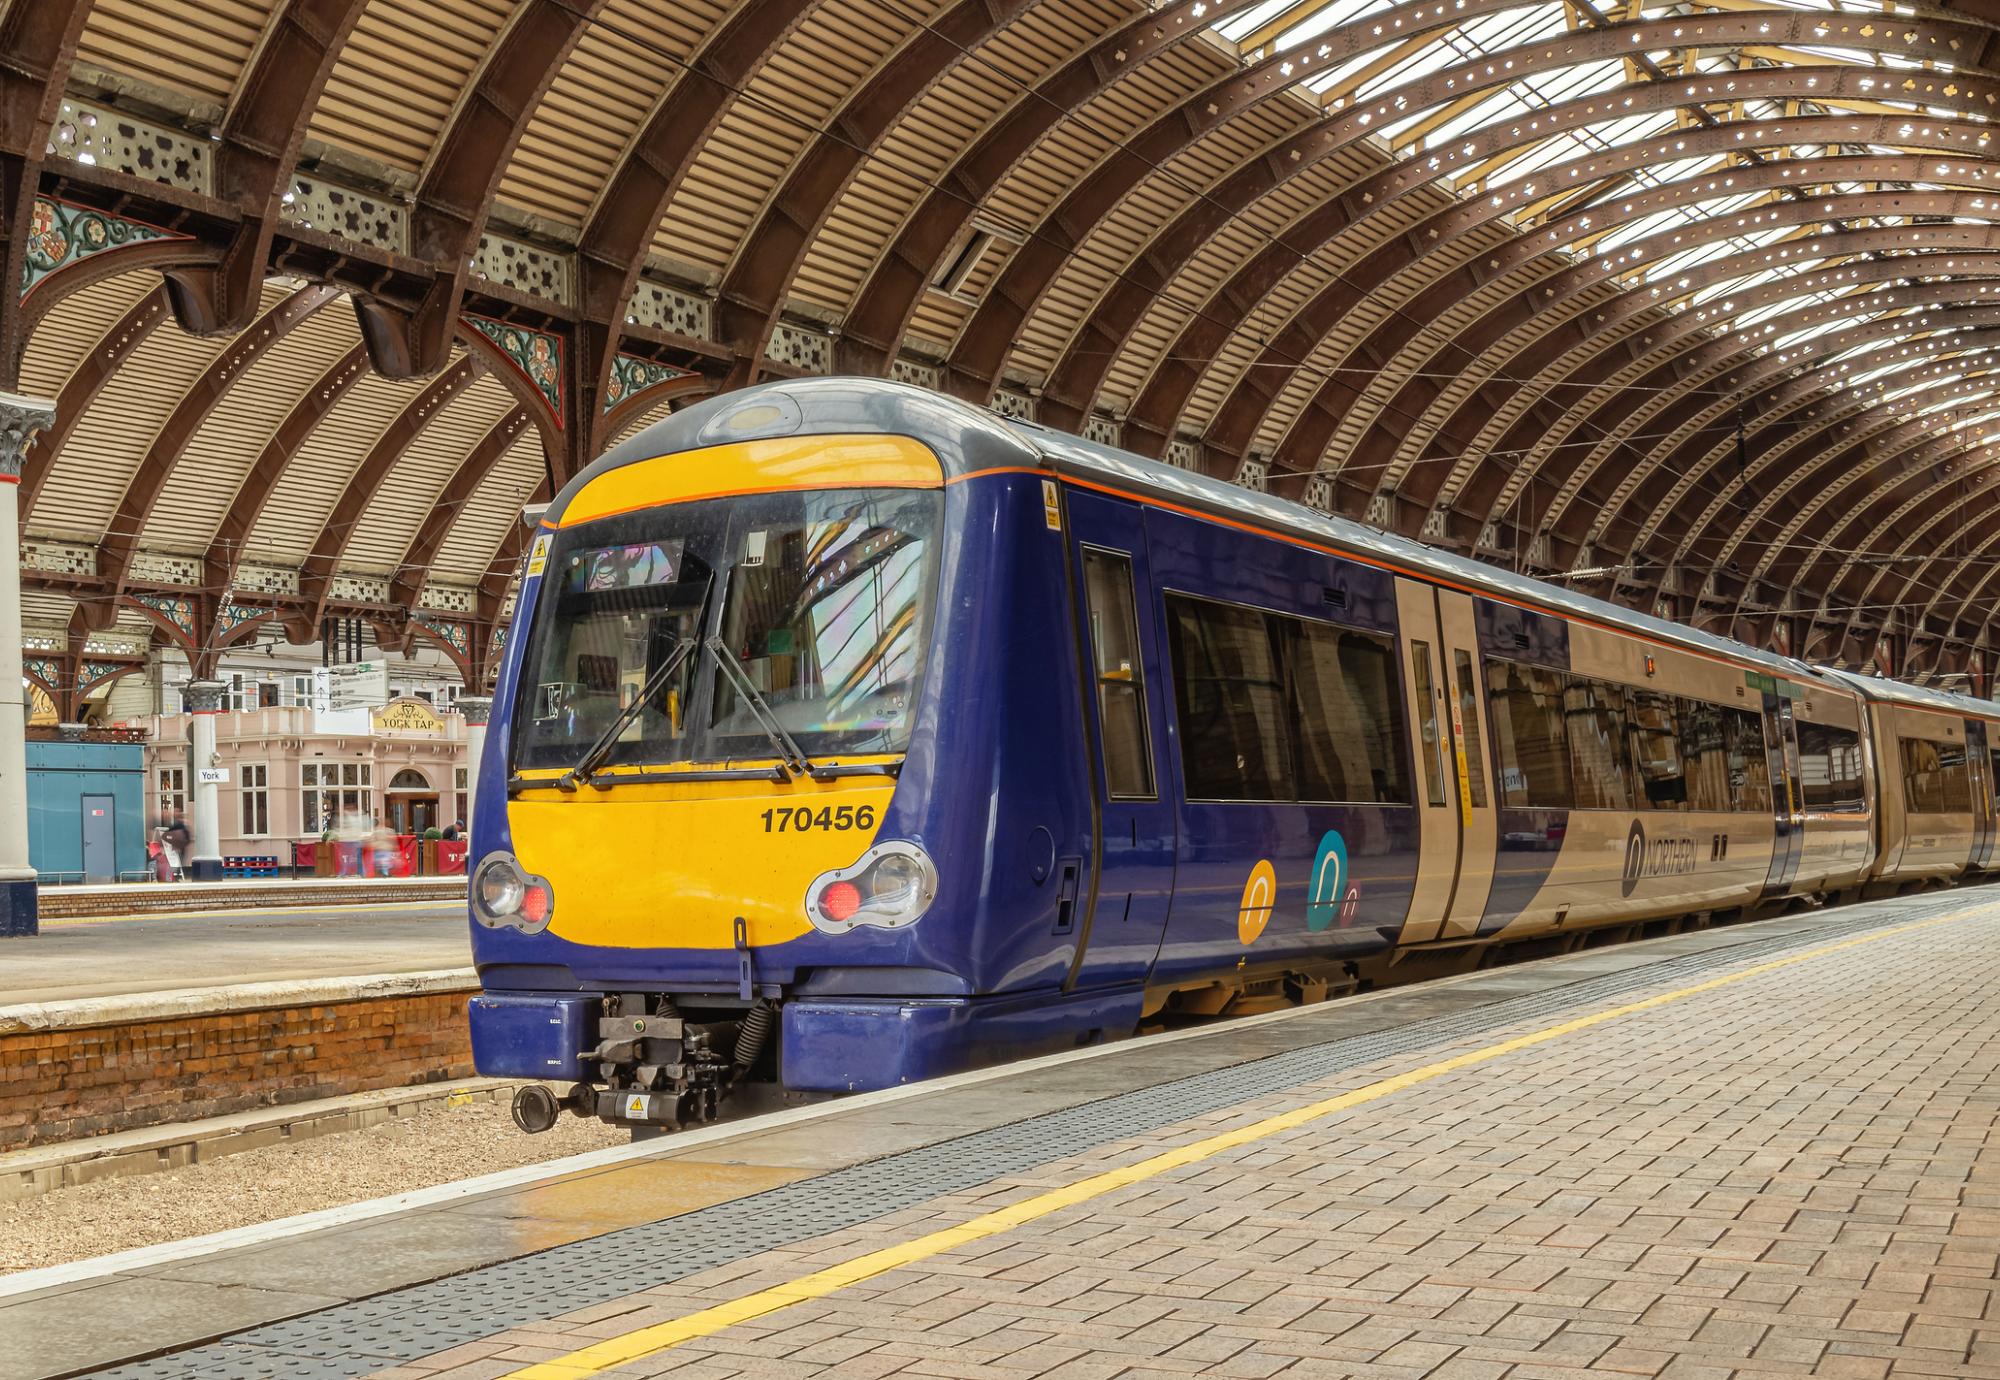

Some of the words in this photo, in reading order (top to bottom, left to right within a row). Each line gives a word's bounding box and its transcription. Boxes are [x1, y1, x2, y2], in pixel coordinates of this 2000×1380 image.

[414, 720, 434, 730] TAP
[202, 771, 220, 780] York
[760, 805, 875, 833] 170456
[1643, 838, 1699, 876] NORTHERN
